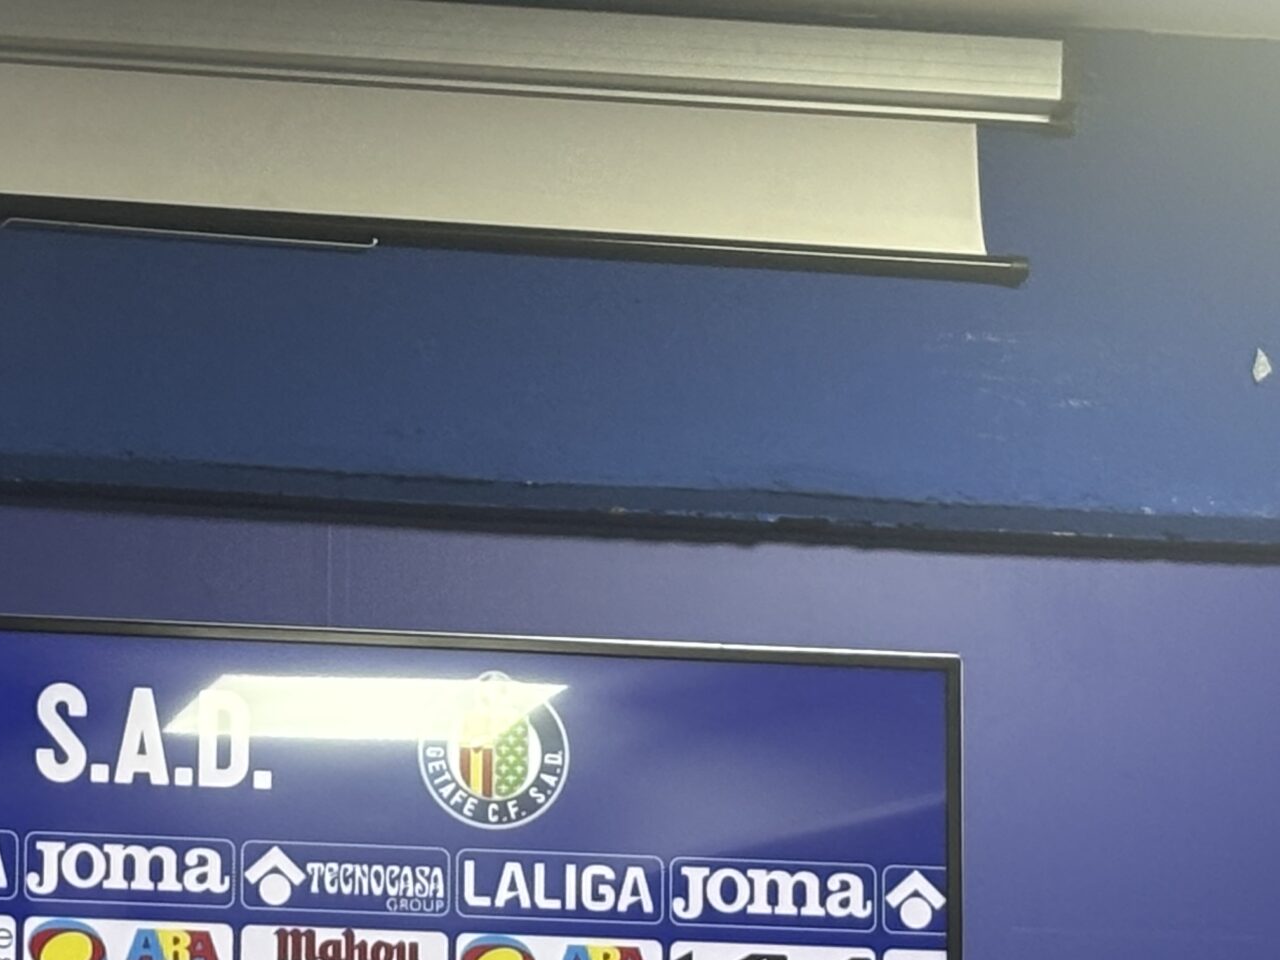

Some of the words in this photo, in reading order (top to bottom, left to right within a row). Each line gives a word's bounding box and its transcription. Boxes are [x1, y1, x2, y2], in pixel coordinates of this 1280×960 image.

[35, 682, 272, 790] S.A.D.
[307, 862, 444, 899] TECNOCASA
[464, 860, 654, 913] LALIGA
[386, 897, 444, 912] GROUP
